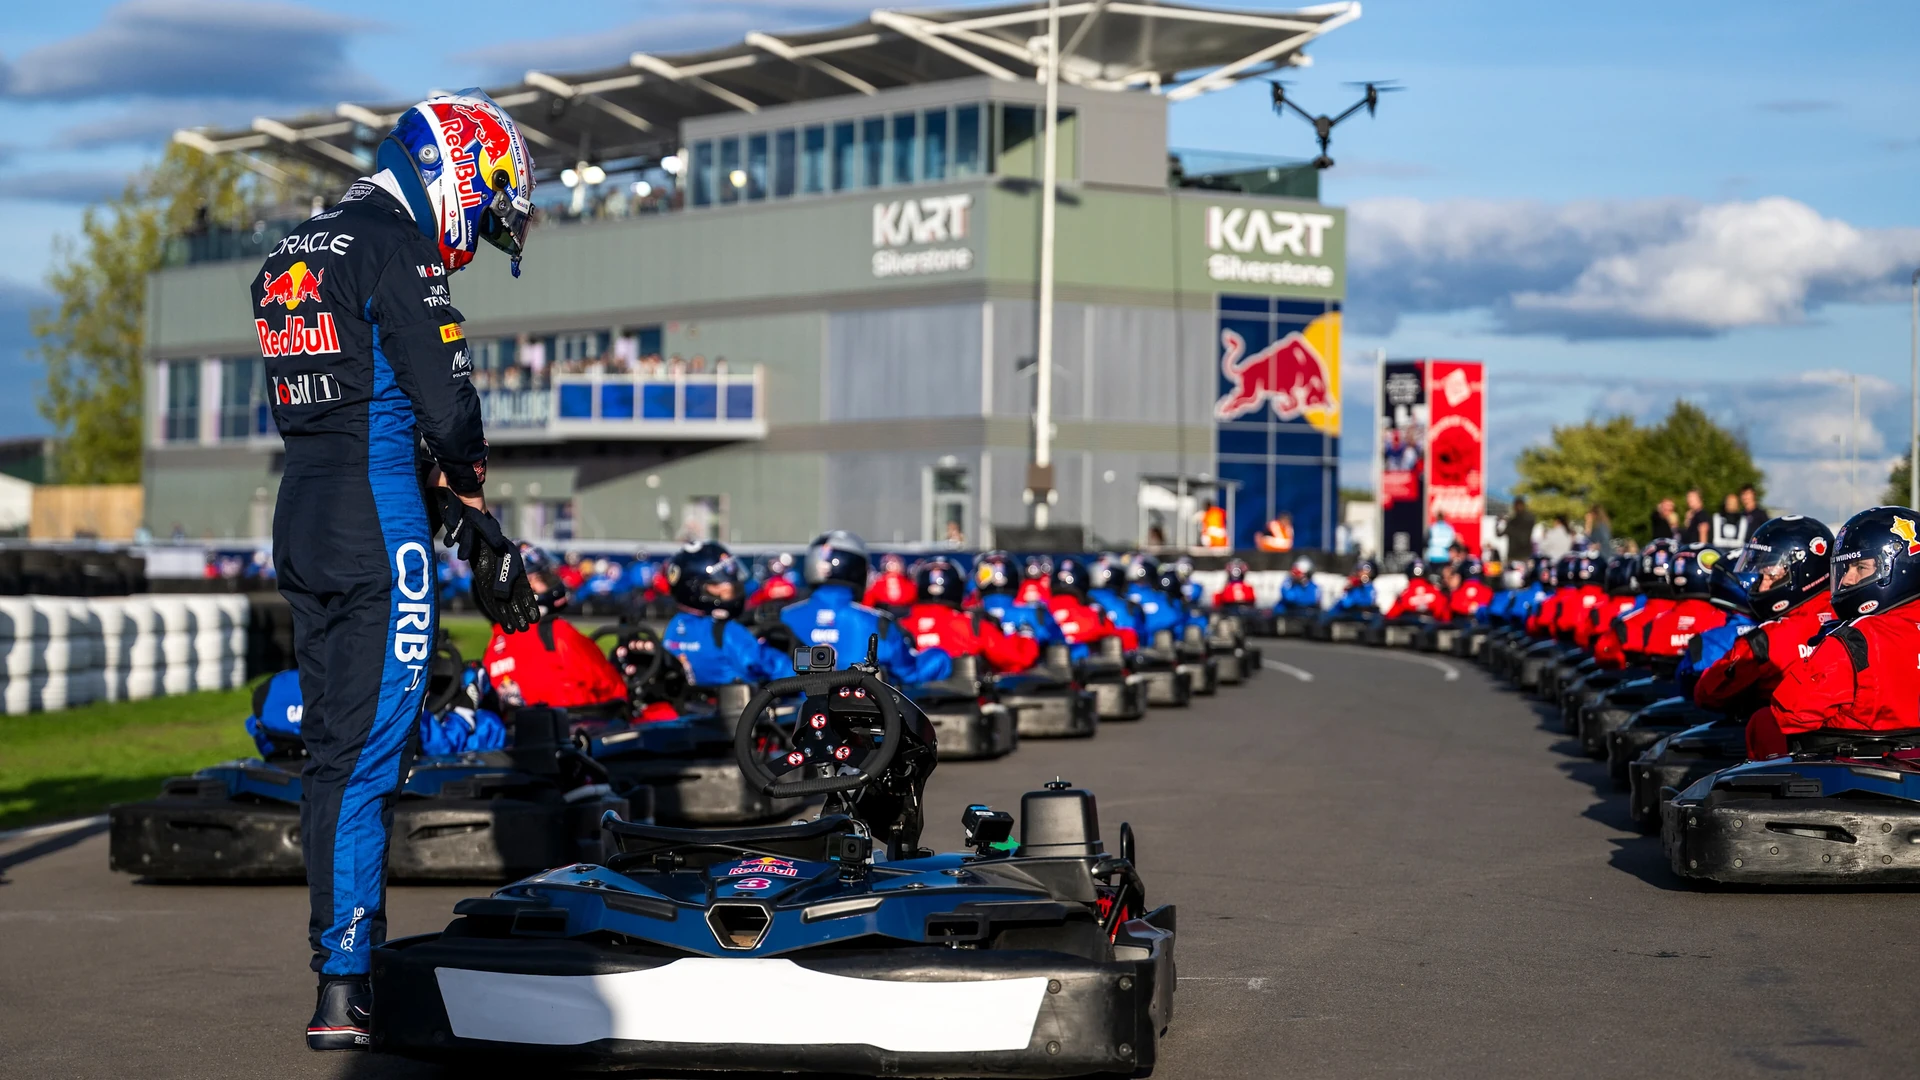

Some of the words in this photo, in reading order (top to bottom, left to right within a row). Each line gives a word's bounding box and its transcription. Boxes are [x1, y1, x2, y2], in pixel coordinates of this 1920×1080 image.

[440, 118, 474, 162] Red
[506, 120, 523, 165] Heineken
[454, 161, 482, 208] Bull
[506, 186, 515, 200] VISA
[873, 193, 973, 248] KART
[1206, 206, 1335, 257] KART
[416, 262, 447, 278] Mobi
[1208, 253, 1335, 288] Silverstone
[423, 295, 450, 307] TRA
[255, 315, 291, 358] Red
[289, 312, 341, 354] Bull
[500, 553, 511, 582] sparco
[729, 865, 762, 875] Red
[764, 865, 798, 877] Bull
[734, 878, 772, 890] 3
